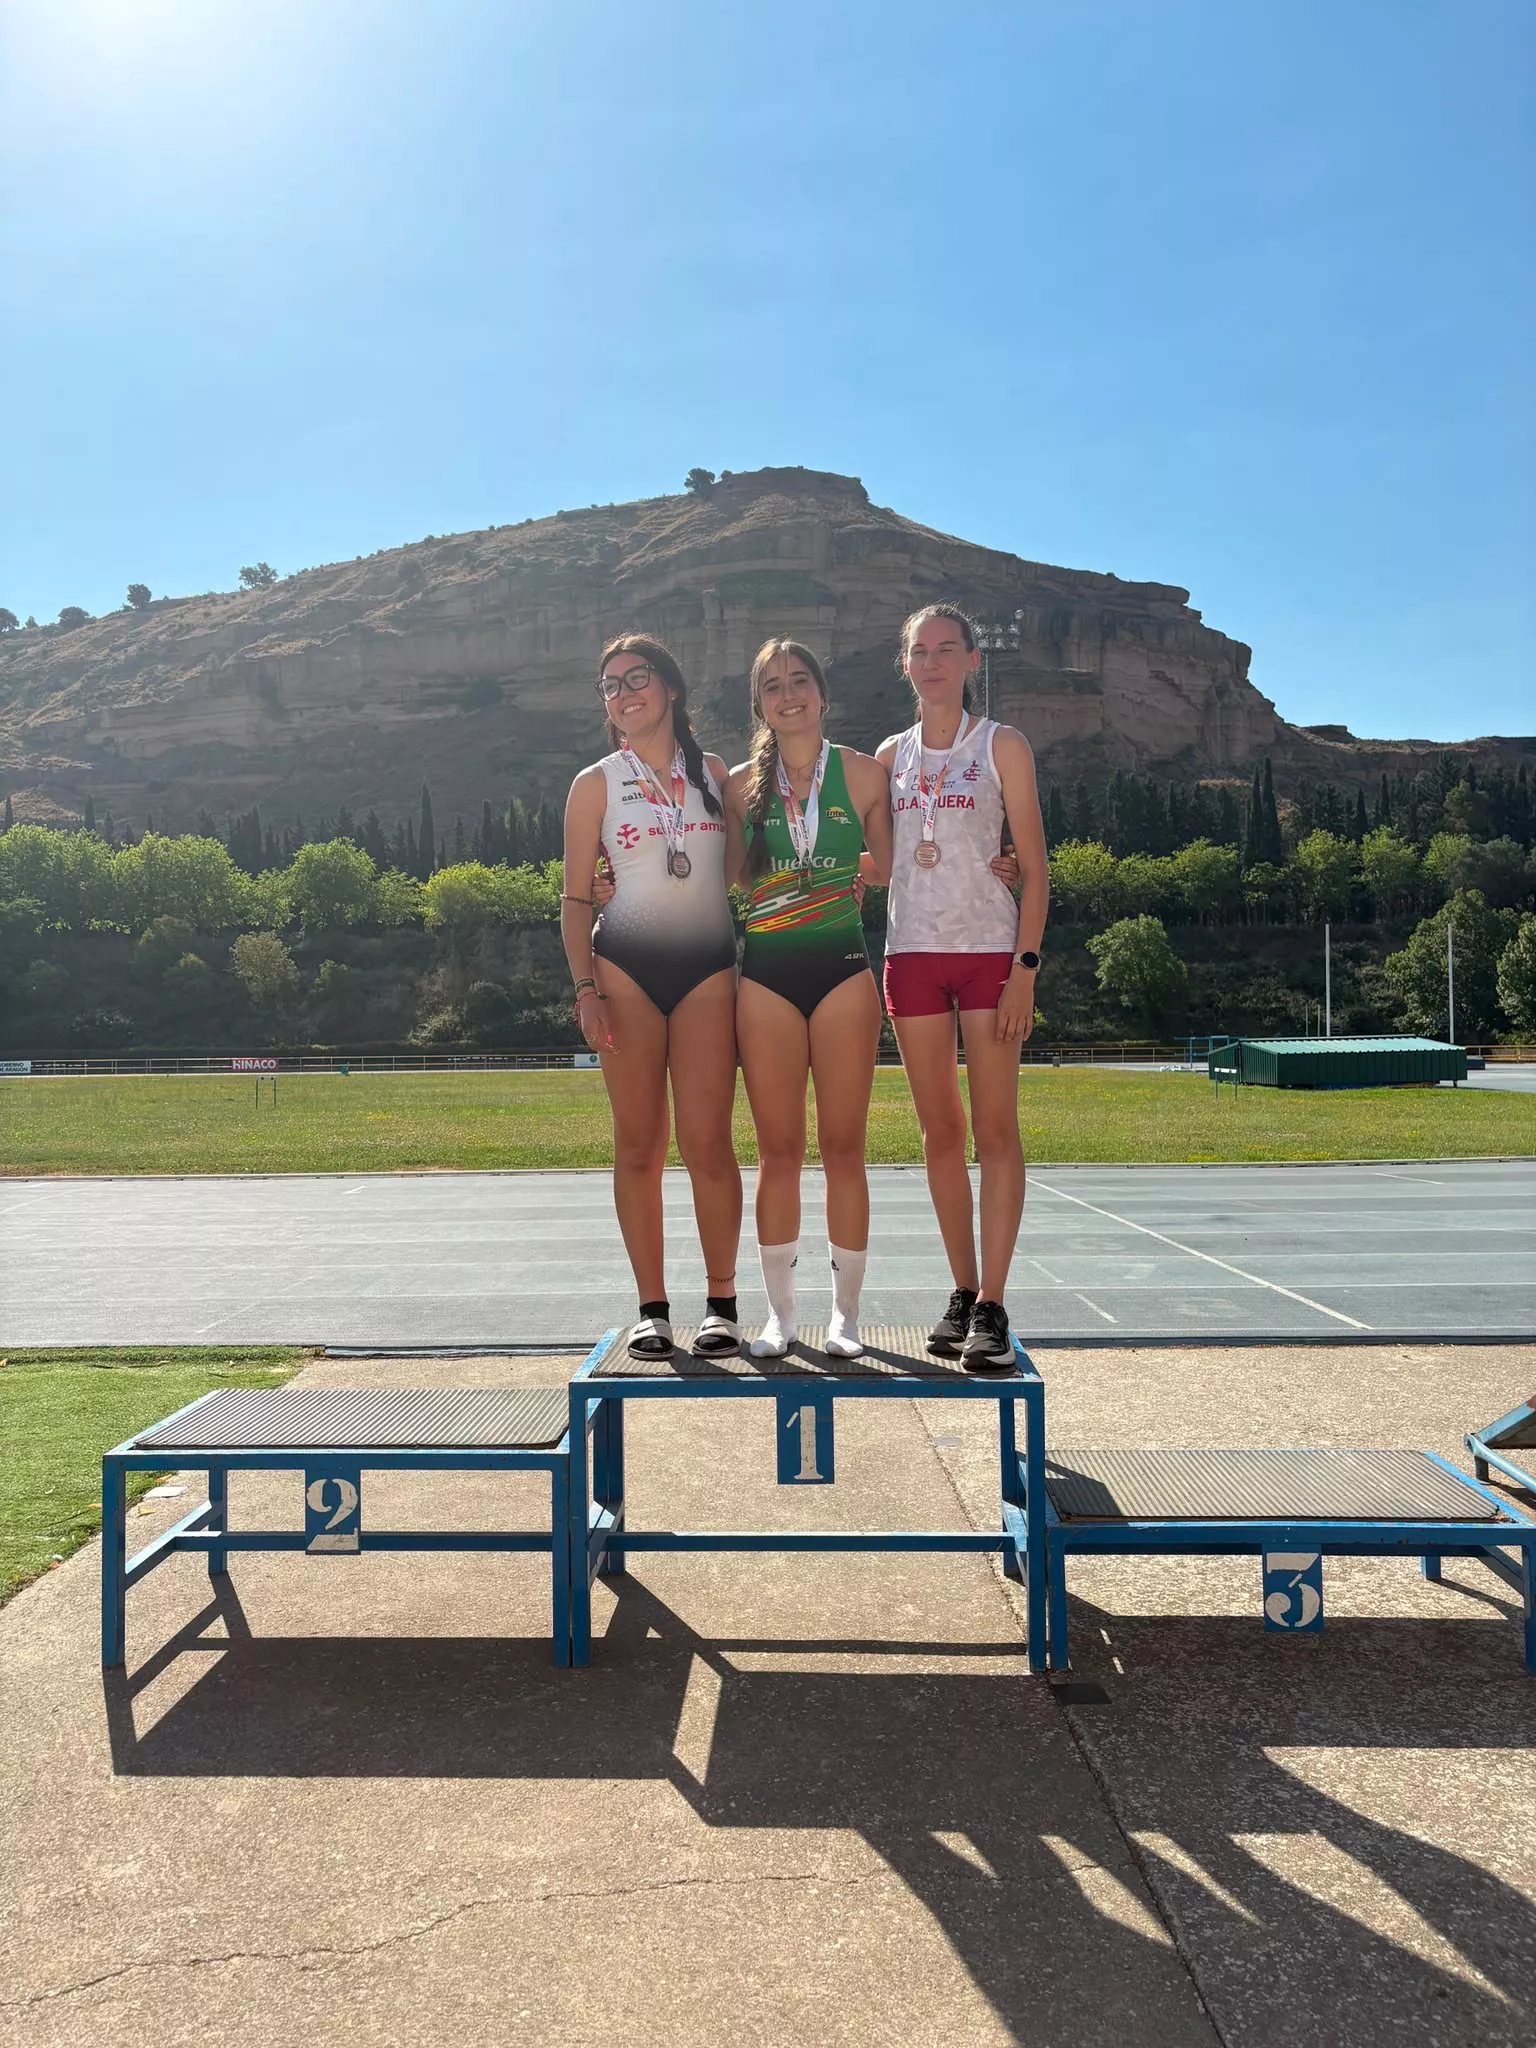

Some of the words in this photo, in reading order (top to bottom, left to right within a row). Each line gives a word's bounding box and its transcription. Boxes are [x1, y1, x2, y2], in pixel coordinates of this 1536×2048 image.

[648, 822, 696, 836] suer
[785, 1405, 824, 1480] 1
[306, 1478, 359, 1551] 2
[1265, 1552, 1321, 1628] 3
